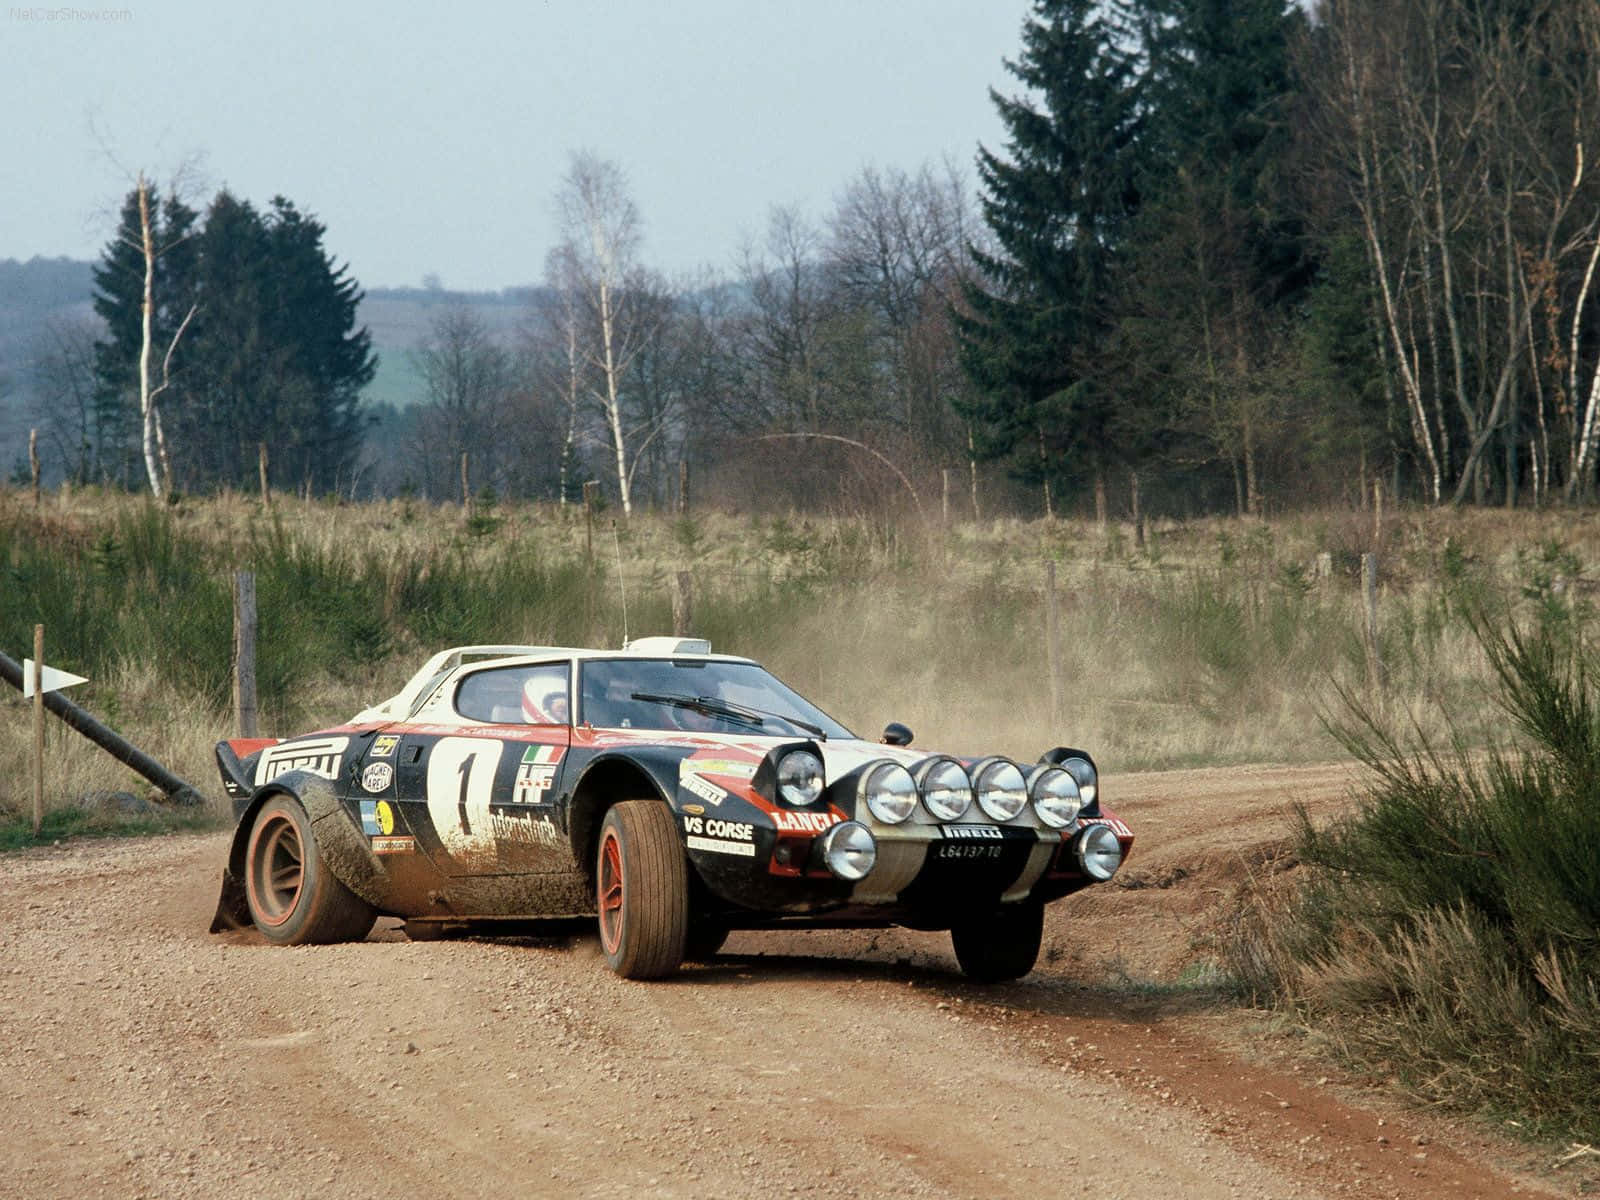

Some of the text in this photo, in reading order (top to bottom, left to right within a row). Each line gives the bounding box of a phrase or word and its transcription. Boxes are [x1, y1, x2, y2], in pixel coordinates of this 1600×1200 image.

[458, 753, 476, 835] 1
[512, 765, 556, 803] HF
[684, 816, 754, 840] VS CORSE
[942, 825, 1004, 839] PIRELLI
